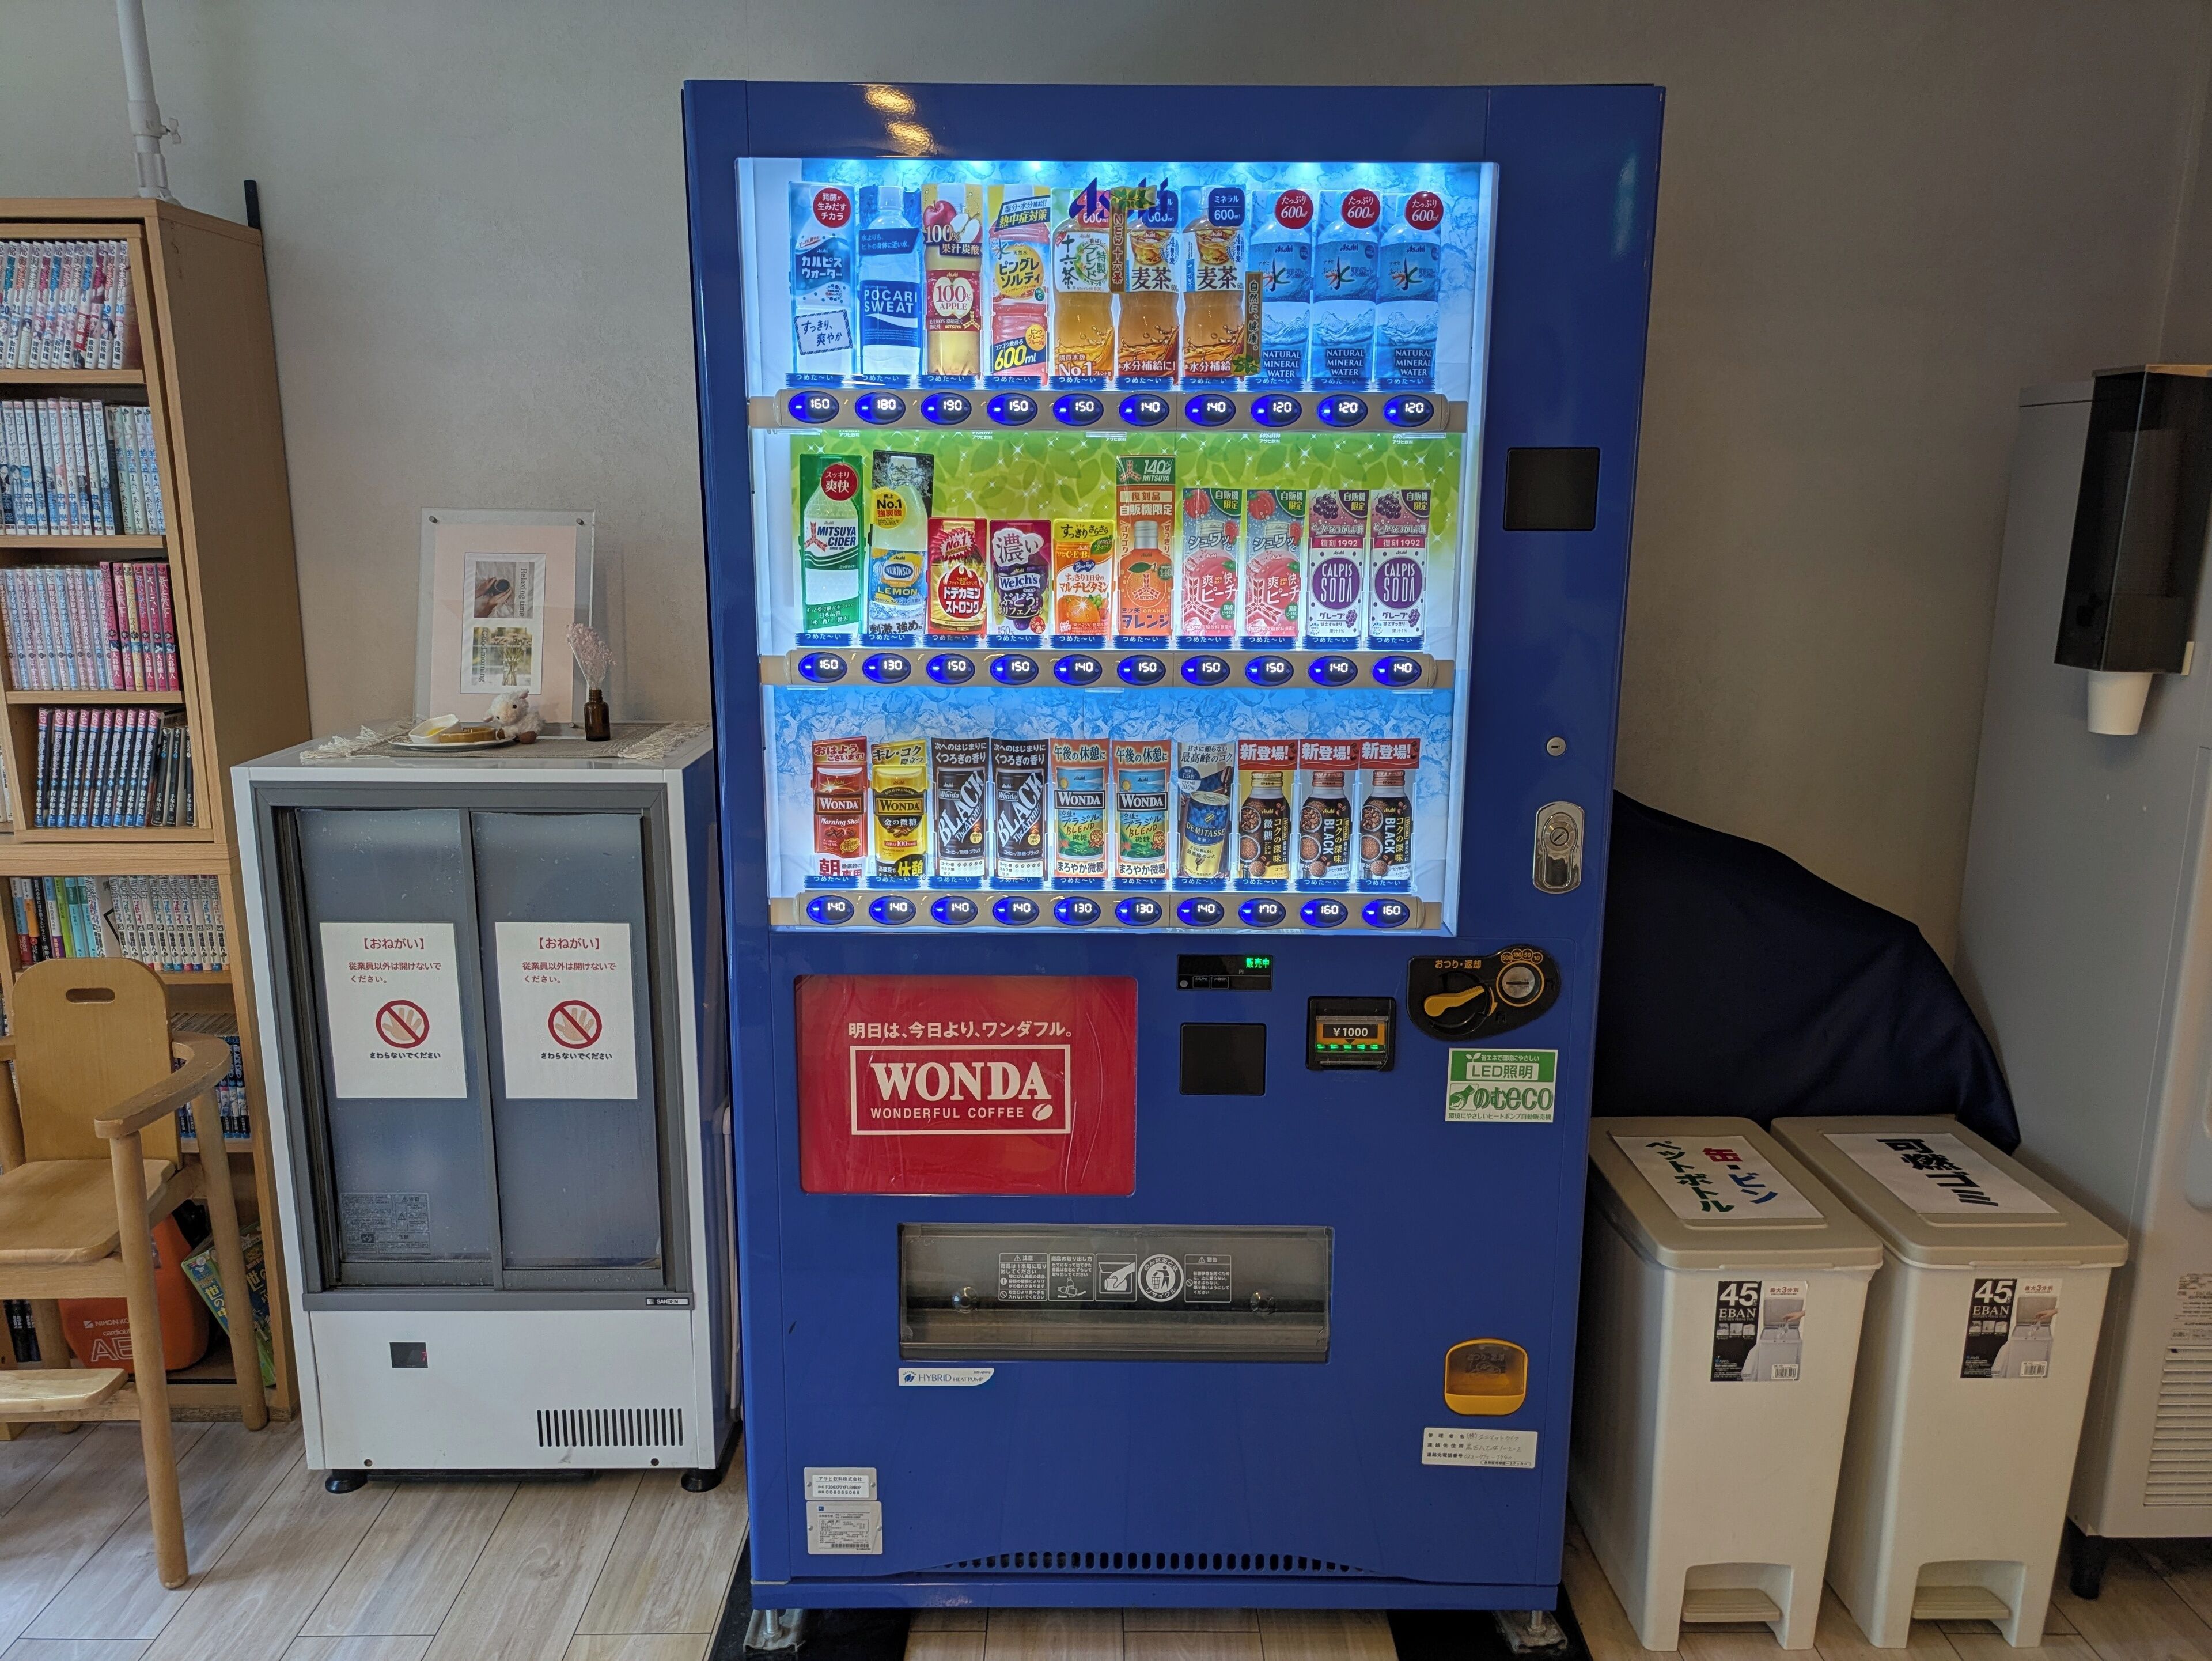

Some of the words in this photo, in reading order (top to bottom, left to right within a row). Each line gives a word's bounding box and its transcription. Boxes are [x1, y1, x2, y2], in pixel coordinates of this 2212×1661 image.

[822, 193, 842, 202] 発酵が
[1214, 195, 1240, 203] ミネラル
[1282, 195, 1306, 205] たっぷり
[1348, 195, 1373, 205] たっぷり
[1412, 198, 1437, 208] たっぷり
[817, 202, 847, 211] 生みだす
[821, 211, 844, 220] チカラ
[999, 210, 1048, 228] 熱中症対策
[1214, 209, 1241, 221] 600ml
[926, 225, 960, 243] 100%
[941, 244, 979, 254] 果汁炭酸
[802, 256, 843, 267] カルピス
[999, 257, 1040, 275] ピングレ
[802, 268, 843, 279] ウォーター
[1131, 266, 1172, 290] 麦茶
[1196, 266, 1237, 290] 麦茶
[1000, 271, 1040, 288] ソルティ
[864, 290, 917, 302] POCARI
[936, 285, 971, 302] 100%
[865, 301, 914, 313] SWEAT
[1247, 281, 1259, 350] 自然に、健康。
[1263, 350, 1301, 359] NATURAL
[1327, 349, 1364, 358] NATURAL
[1263, 359, 1300, 368] MINERAL
[1327, 358, 1363, 367] MINERAL
[1267, 369, 1295, 377] WATER
[1331, 368, 1358, 376] WATER
[810, 398, 830, 410] 160
[877, 399, 896, 411] 180
[944, 400, 962, 411] 190
[1009, 400, 1028, 411] 150
[1075, 401, 1094, 413] 150
[1141, 402, 1160, 413] 140
[1207, 402, 1226, 413] 140
[1272, 402, 1292, 413] 120
[1339, 402, 1358, 413] 120
[1405, 402, 1424, 413] 120
[825, 471, 849, 479] スッキリ
[825, 479, 849, 493] 爽快
[1131, 492, 1160, 501] 復刻品
[1215, 490, 1238, 500] 自販機
[1343, 491, 1366, 502] 自販機
[876, 499, 902, 509] No.1
[1224, 501, 1238, 510] 限定
[1351, 502, 1365, 511] 限定
[877, 509, 902, 517] 強炭酸
[1120, 504, 1173, 516] 自販機限定
[817, 525, 856, 537] MITSUYA
[827, 536, 856, 547] CIDER
[1320, 539, 1336, 547] 復刻
[1338, 539, 1358, 547] 1992
[997, 534, 1039, 563] 濃い
[885, 566, 912, 576] WILKINSON
[1321, 563, 1353, 577] CALPIS
[520, 568, 528, 601] Relaxing
[999, 574, 1038, 590] Welch's
[877, 587, 918, 596] LEMON
[944, 585, 980, 601] ドデカミン
[1059, 582, 1109, 594] マルチビタミン
[1320, 578, 1353, 603] SODA
[945, 601, 979, 614] ストロング
[1319, 612, 1345, 620] グレープ
[480, 630, 488, 653] Good
[478, 654, 487, 683] morning
[819, 660, 838, 670] 160
[884, 660, 903, 670] 130
[948, 661, 967, 671] 150
[815, 744, 858, 755] おはよう
[934, 742, 986, 750] 次へのはじまりに
[993, 744, 1046, 752] 次へのはじまりに
[1362, 741, 1411, 760] 新登場!
[935, 752, 986, 763] くつろぎの香り
[1054, 745, 1106, 762] 午後の休憩に
[1116, 747, 1168, 763] 午後の休憩に
[1181, 751, 1232, 763] 最高峰のコク
[1240, 743, 1289, 762] 新登場!
[1302, 743, 1351, 762] 新登場!
[995, 754, 1045, 766] くつろぎの香り
[819, 798, 859, 811] WONDA
[1058, 794, 1101, 806] WONDA
[938, 771, 984, 846] BLACK
[821, 818, 844, 826] Morning
[883, 817, 916, 827] 金の微糖
[1066, 823, 1095, 835] BLEND
[1187, 822, 1225, 837] DEMITASSE
[1272, 818, 1282, 864] コクの深味
[1324, 818, 1335, 855] BLACK
[1334, 818, 1342, 864] コクの深味
[1058, 862, 1104, 873] まろやか微糖
[1120, 864, 1166, 875] まろやか微糖
[827, 902, 845, 911] 140
[889, 902, 907, 912] 140
[1074, 903, 1092, 913] 130
[1137, 904, 1154, 913] 130
[1259, 905, 1277, 914] 170
[1320, 905, 1339, 915] 160
[1382, 905, 1401, 915] 160
[363, 937, 425, 951] 【おねがい】
[539, 937, 601, 951] 【おねがい】
[349, 962, 442, 971] 従業員以外は開けないで
[522, 962, 616, 971] 従業員以外は開けないで
[1246, 958, 1270, 968] 販売中
[1435, 960, 1481, 969] おつり・返却
[350, 975, 389, 984] ください。
[525, 975, 563, 984] ください。
[848, 1020, 1072, 1039] 明日は、今日より、ワンダフル。
[369, 1051, 441, 1060] さわらないでください
[541, 1051, 612, 1060] さわらないでください
[1472, 1065, 1533, 1079] LED照明
[870, 1061, 1052, 1101] WONDA
[1473, 1087, 1553, 1111] のむeco
[870, 1107, 960, 1119] WONDERFUL
[968, 1107, 1024, 1119] COFFEE
[1448, 1113, 1551, 1121] 環境にやさしいヒートポンプ自動販売機
[1645, 1141, 1734, 1212] ペットボトル
[1876, 1137, 1999, 1208] 可燃ゴミ
[1144, 1257, 1179, 1272] のんだあとは
[1146, 1288, 1176, 1298] リサイクル
[1719, 1308, 1756, 1318] EBAN
[1972, 1306, 2010, 1315] EBAN
[91, 1337, 133, 1362] AE
